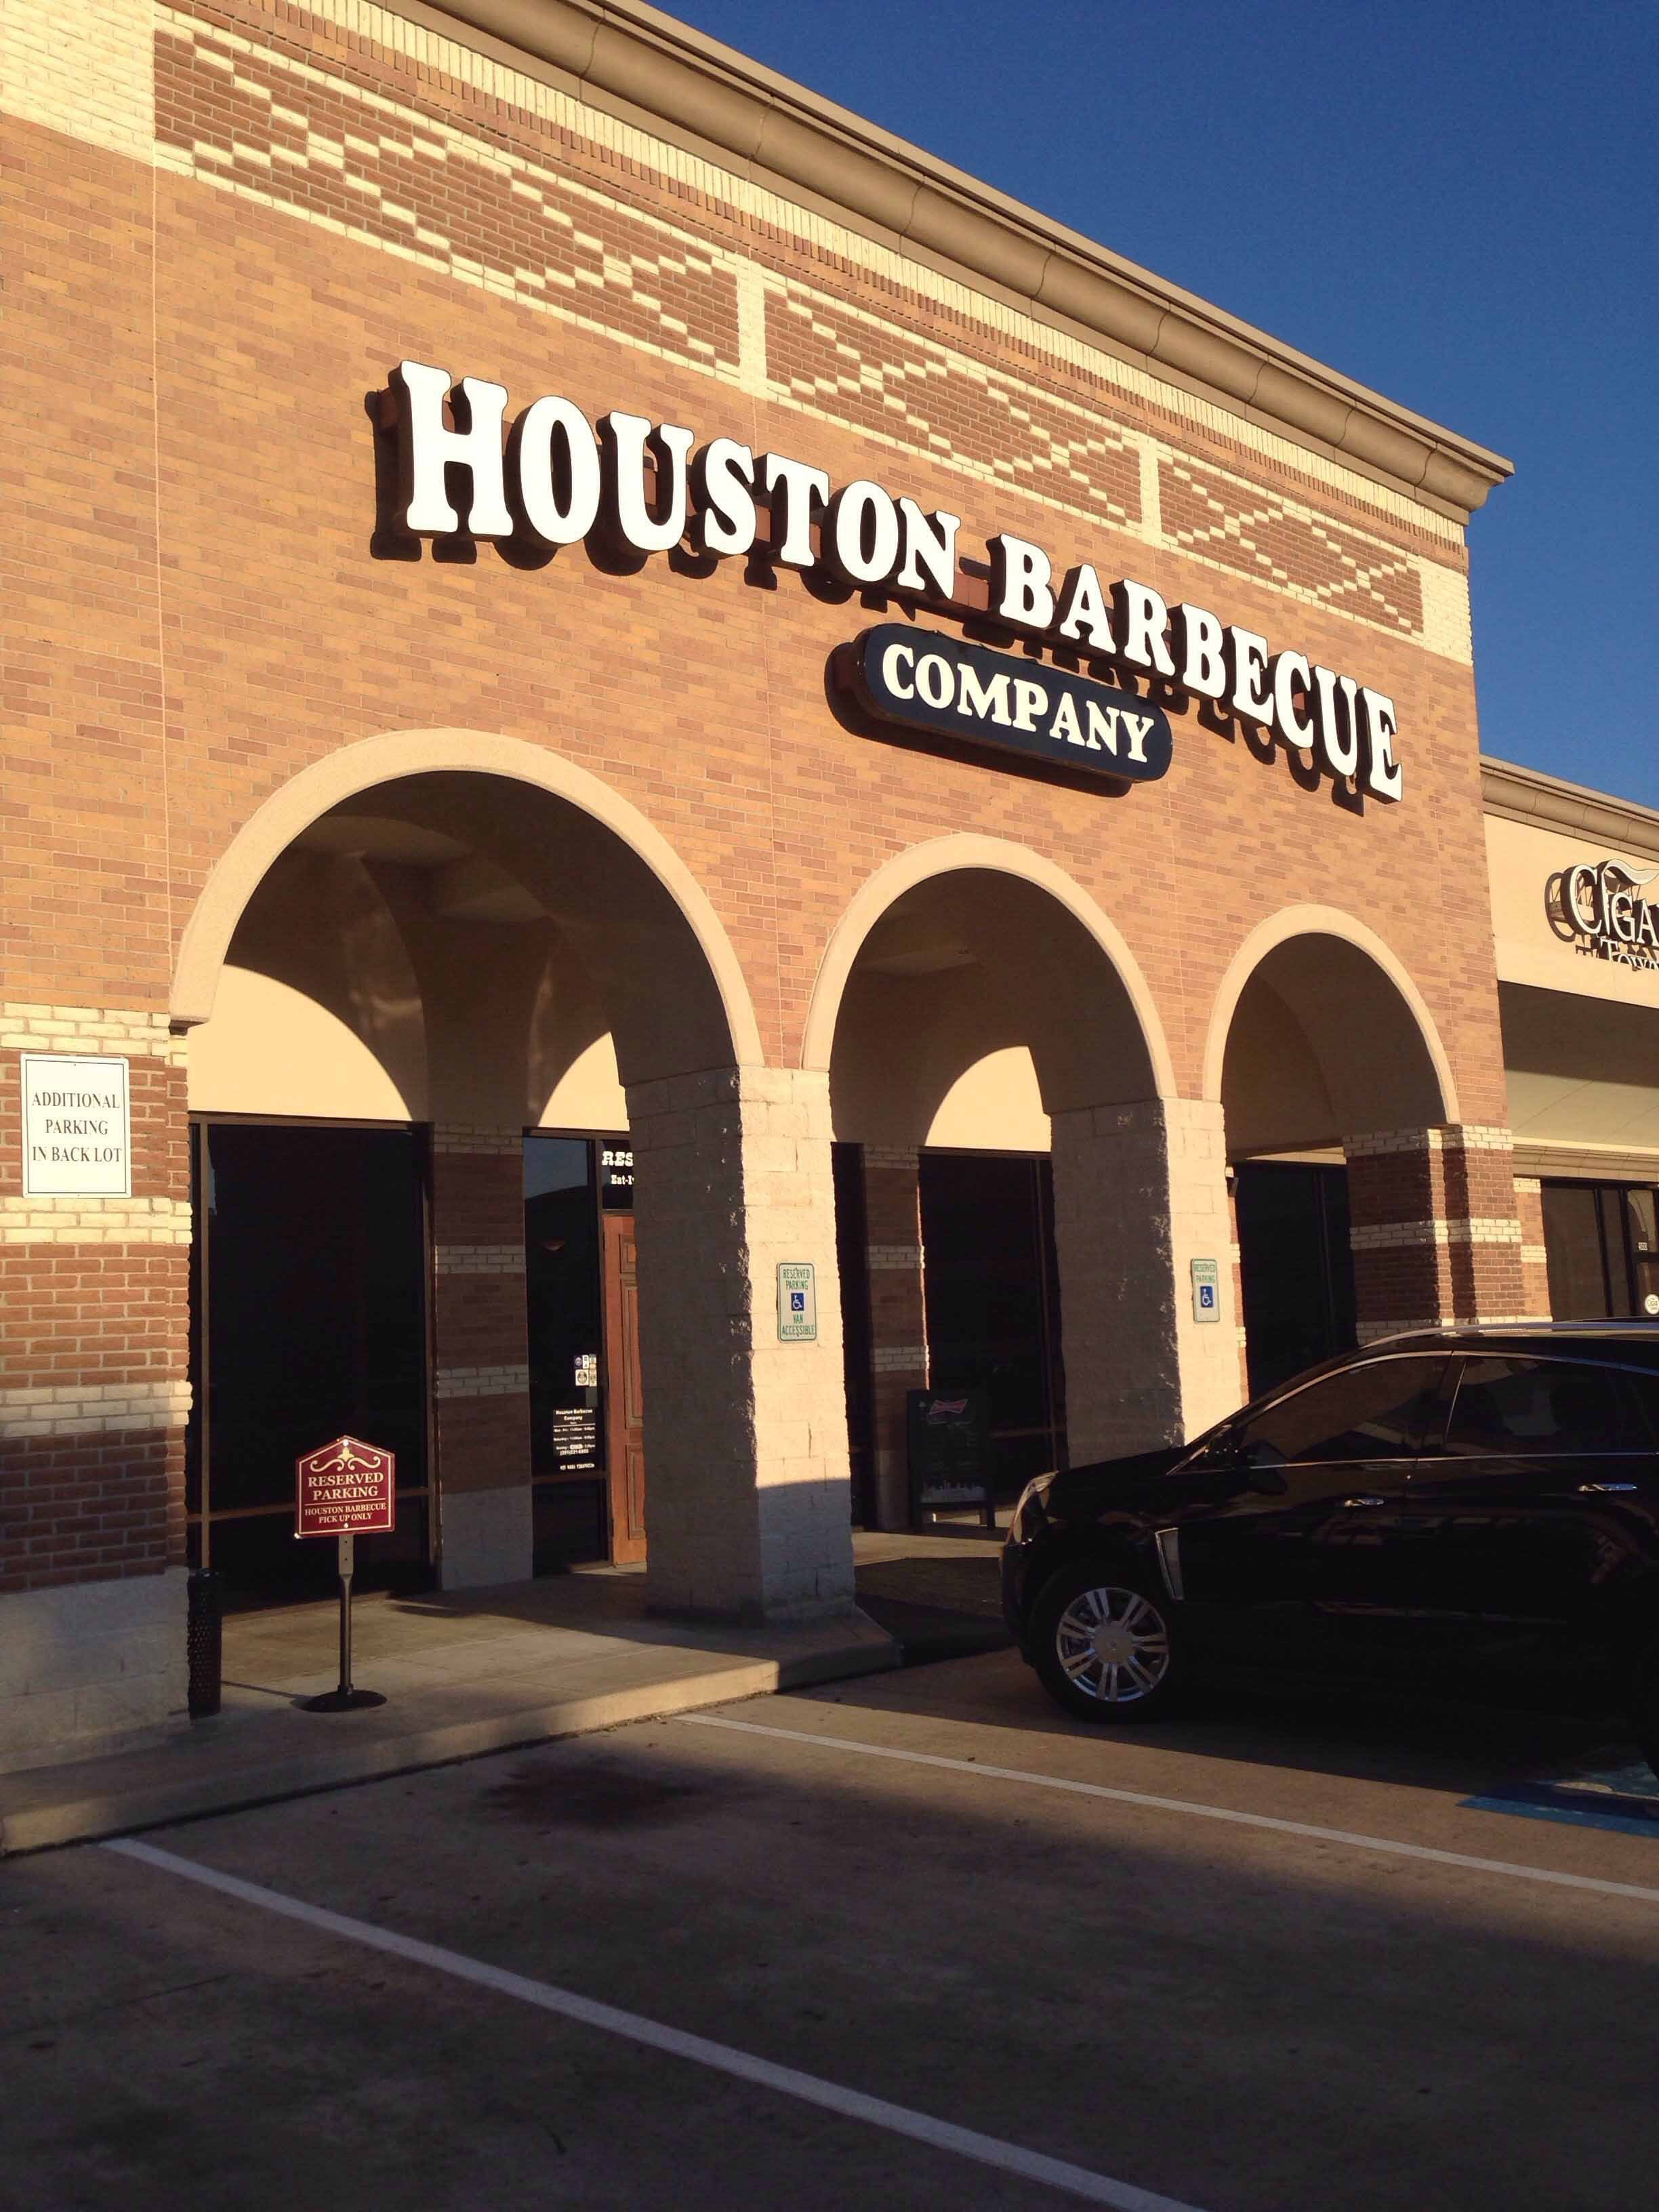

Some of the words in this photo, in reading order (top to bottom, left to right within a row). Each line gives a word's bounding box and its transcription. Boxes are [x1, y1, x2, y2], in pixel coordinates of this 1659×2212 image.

[401, 360, 961, 600] HOUSTON
[998, 533, 1402, 802] BARBECUE
[882, 642, 1155, 764] COMPANY
[1570, 859, 1659, 947] CIGA
[32, 1092, 120, 1108] ADDITIONAL
[45, 1119, 108, 1135] PARKING
[32, 1146, 47, 1161] IN
[52, 1147, 90, 1162] BACK
[94, 1147, 122, 1162] LOT
[611, 1174, 634, 1185] Eat-I
[782, 1268, 811, 1279] RESERVED
[785, 1279, 808, 1290] PARKING
[793, 1313, 804, 1324] VAN
[781, 1325, 815, 1336] ACCESSIBLE
[308, 1472, 384, 1488] RESERVED
[312, 1486, 379, 1501] PARKING
[305, 1504, 344, 1516] HOUSTON
[345, 1502, 387, 1513] BARBECUE
[319, 1515, 338, 1524] PICK
[339, 1513, 350, 1522] UP
[351, 1511, 373, 1521] ONLY
